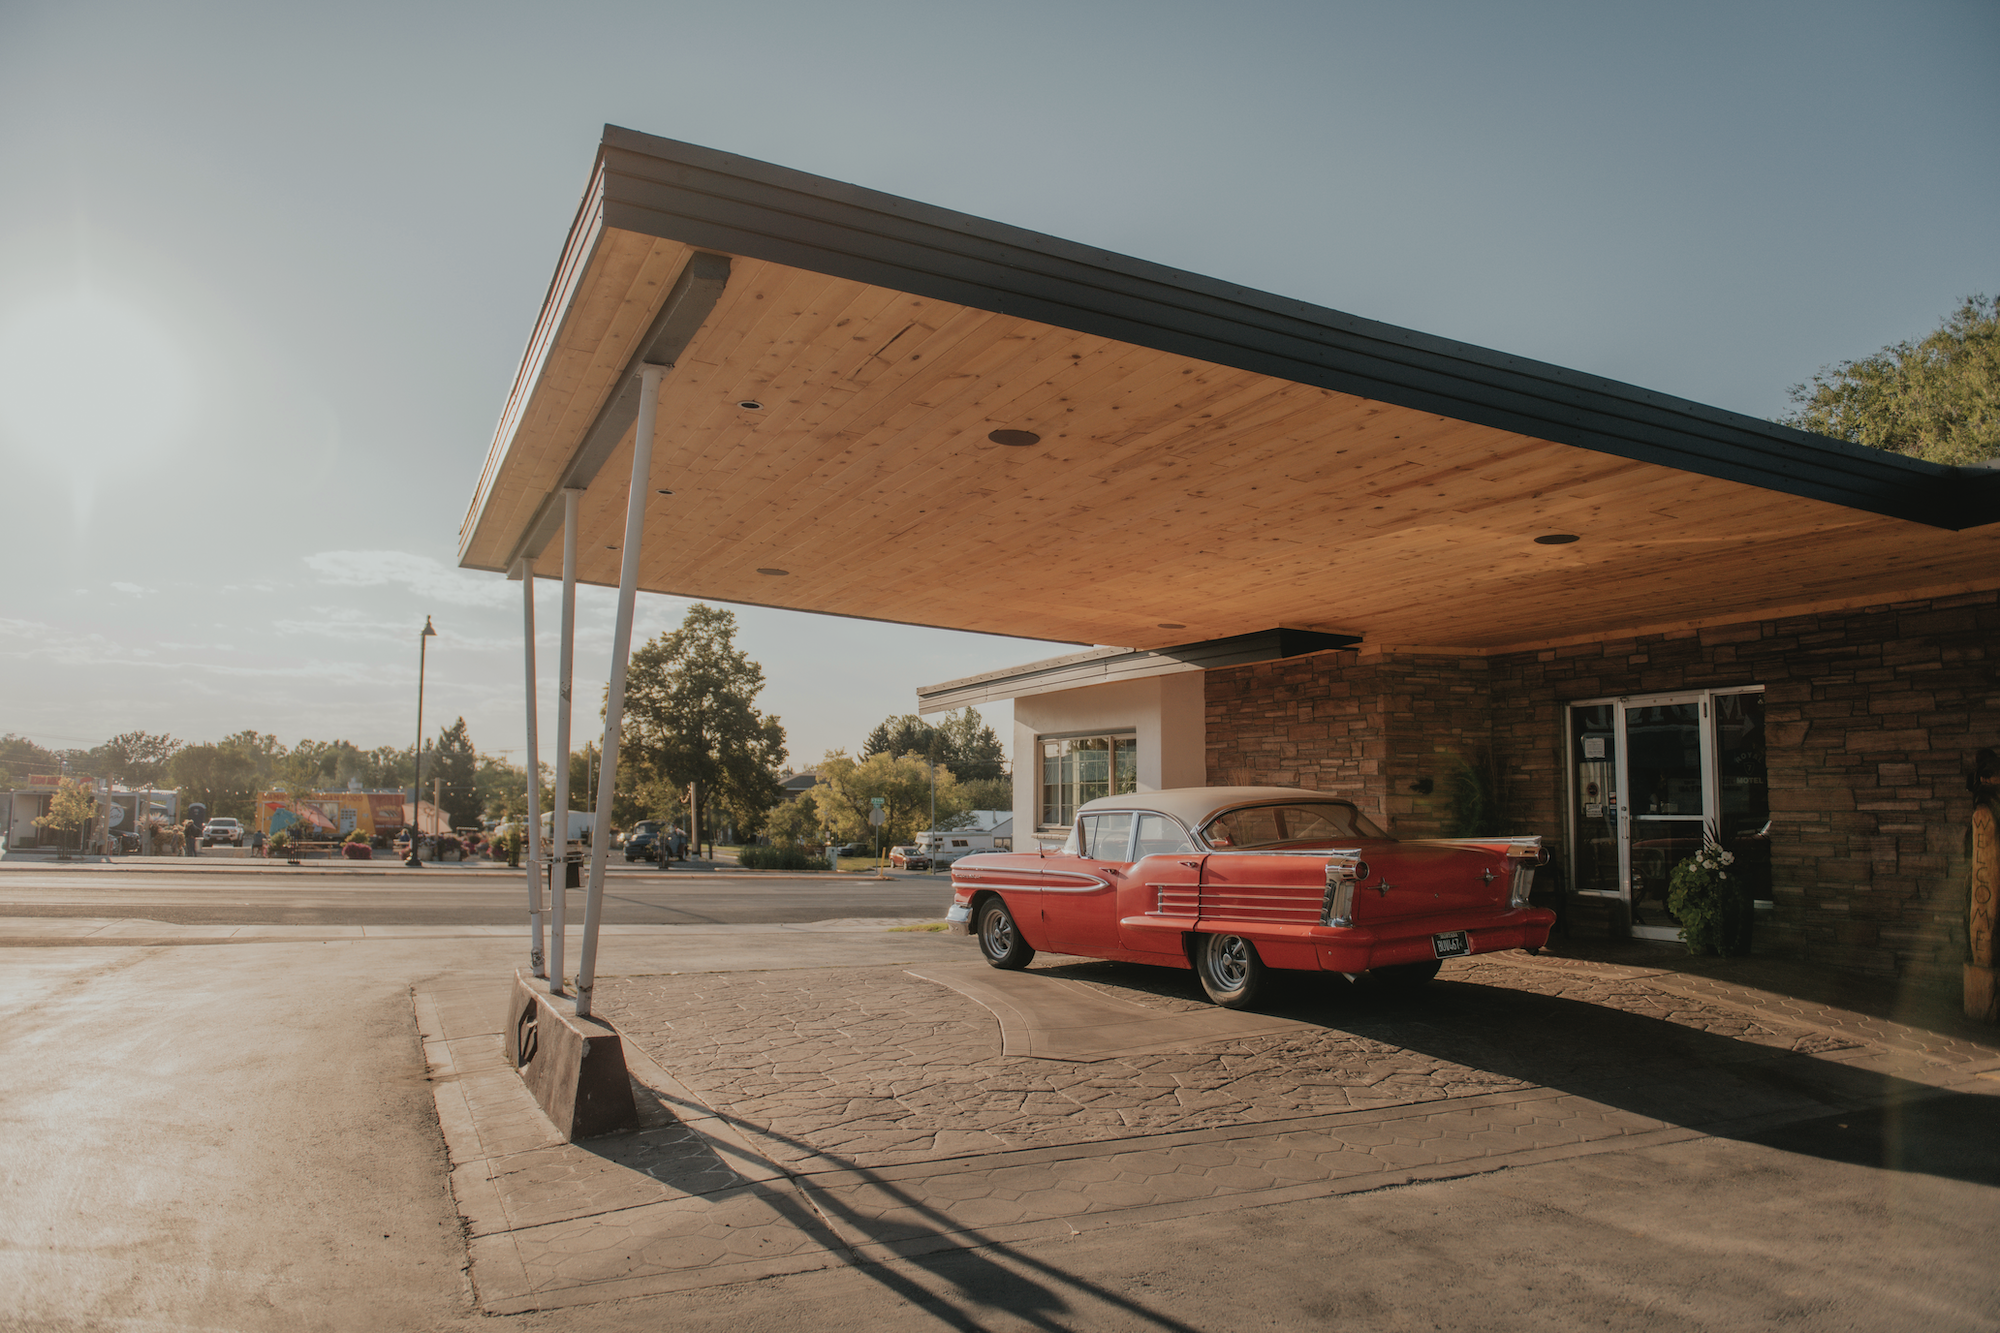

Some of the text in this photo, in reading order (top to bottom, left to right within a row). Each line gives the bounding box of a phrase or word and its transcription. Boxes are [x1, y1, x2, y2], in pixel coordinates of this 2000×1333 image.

[1735, 752, 1763, 764] ROYAL
[1747, 764, 1752, 772] 7
[1971, 817, 1990, 953] WELCOME
